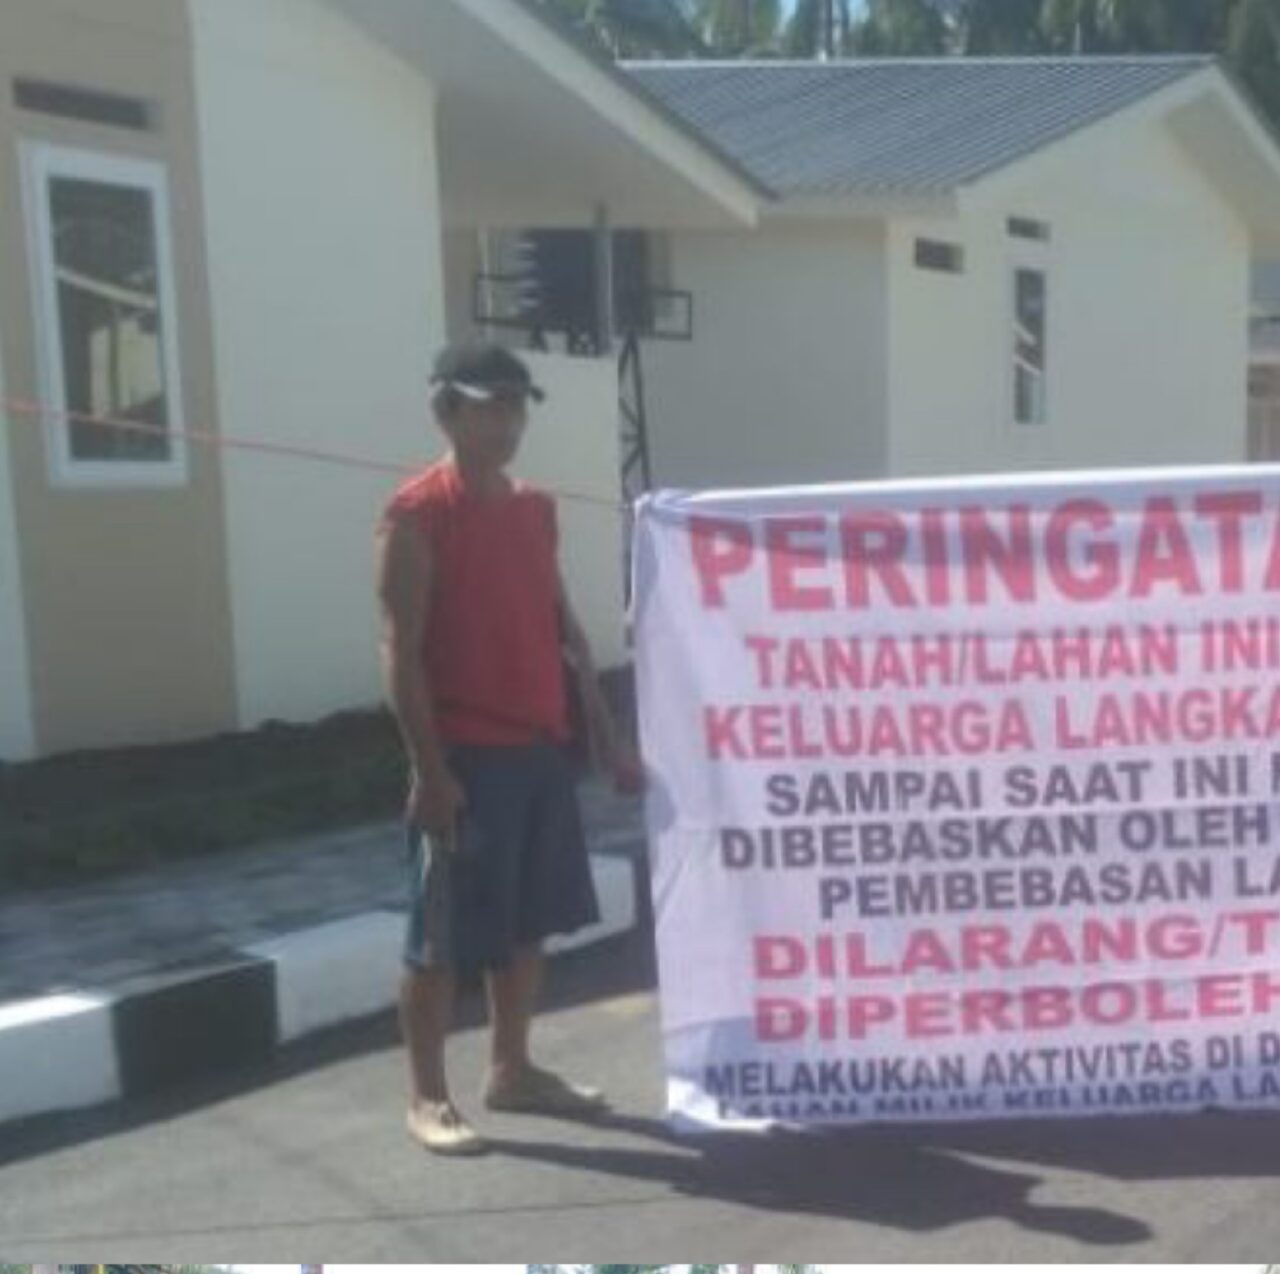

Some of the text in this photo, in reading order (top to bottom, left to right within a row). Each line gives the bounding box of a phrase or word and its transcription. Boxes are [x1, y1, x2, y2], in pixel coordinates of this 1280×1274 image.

[745, 623, 1178, 690] TANAH/LAHAN
[1201, 616, 1280, 672] INI
[704, 700, 1034, 760] KELUARGA
[766, 770, 982, 816] SAMPAI
[1005, 758, 1151, 808] SAAT
[1174, 755, 1248, 800] INI
[721, 814, 1097, 870] DIBEBASKAN
[1120, 804, 1270, 852] OLEH
[819, 858, 1211, 919] PEMBEBASAN
[705, 1054, 965, 1099] MELAKUKAN
[982, 1038, 1193, 1087] AKTIVITAS
[1205, 1035, 1244, 1070] DI
